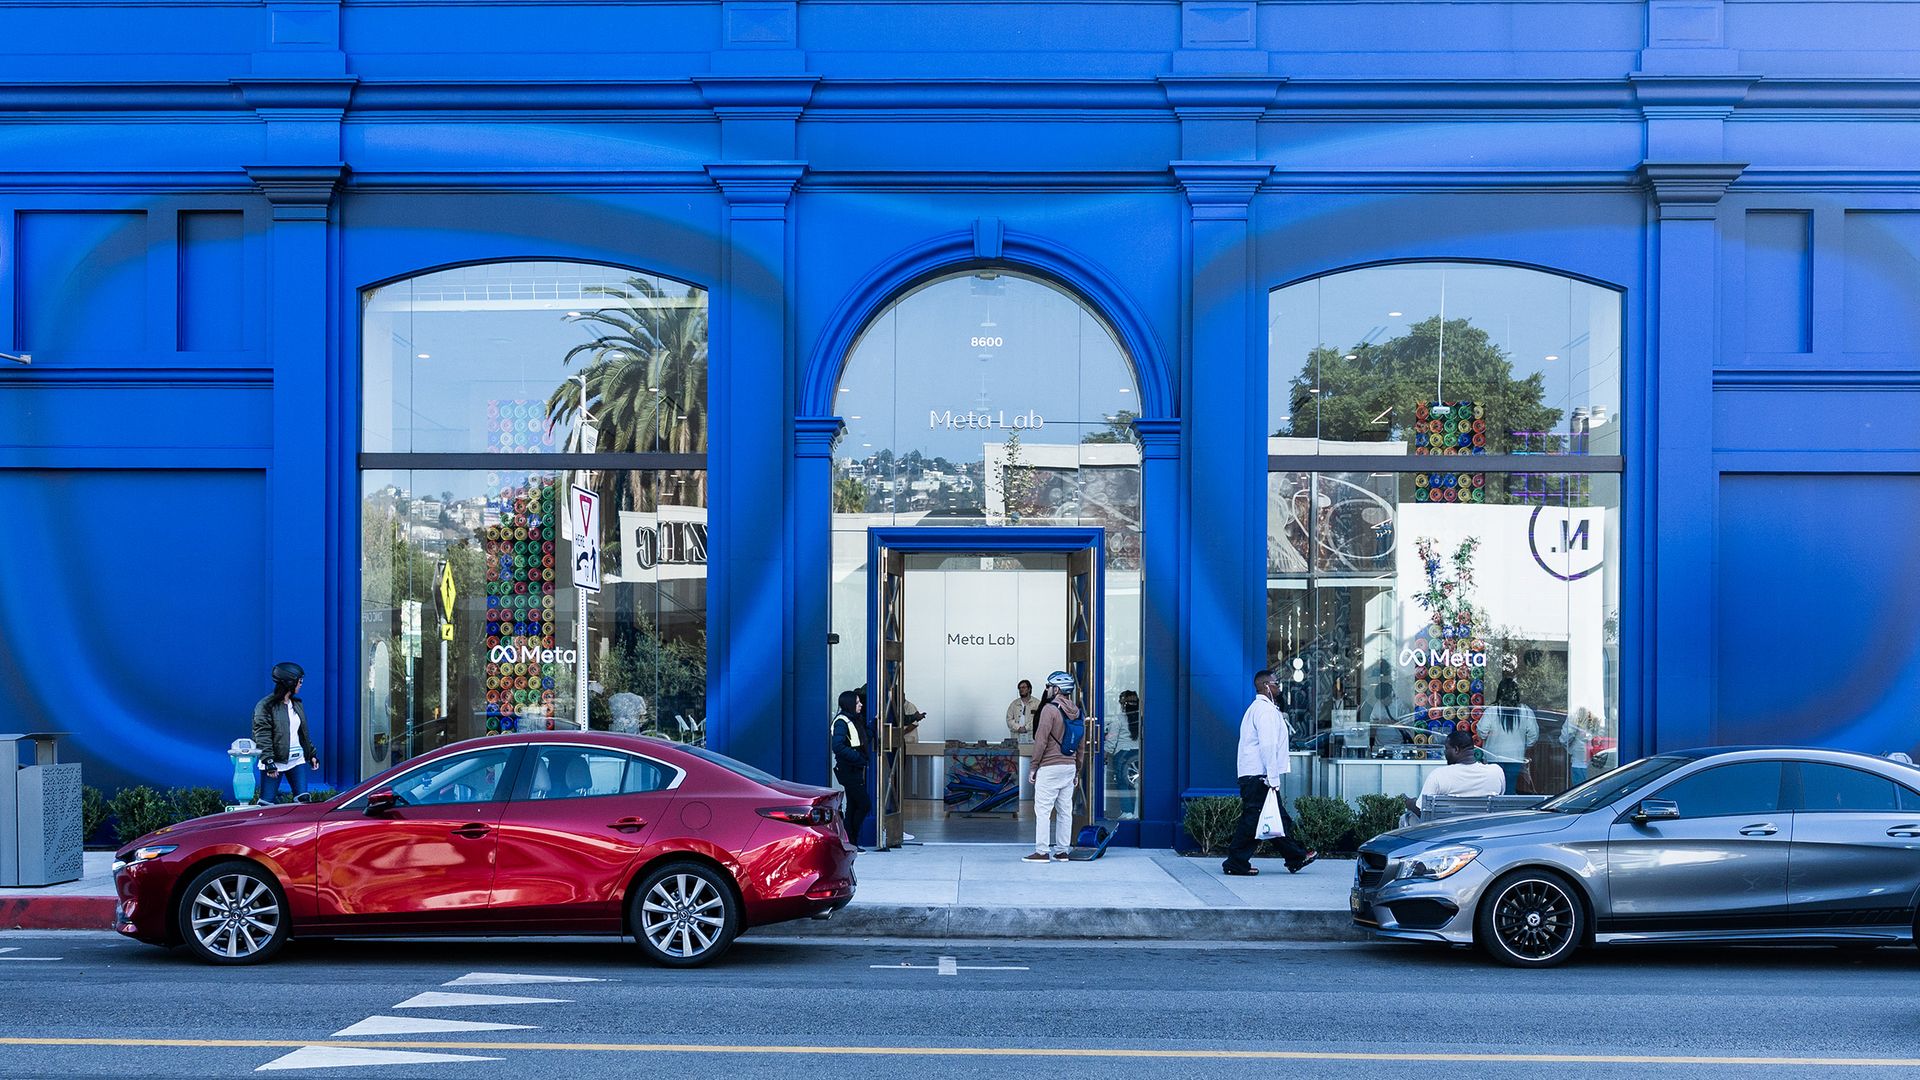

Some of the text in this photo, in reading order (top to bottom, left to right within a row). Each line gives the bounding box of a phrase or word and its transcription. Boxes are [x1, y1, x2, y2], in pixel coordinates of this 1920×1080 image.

[971, 336, 1003, 347] 8600
[930, 409, 1044, 429] Meta Lab
[947, 633, 1015, 645] Meta Lab
[521, 645, 576, 664] Meta
[1430, 648, 1486, 667] Meta
